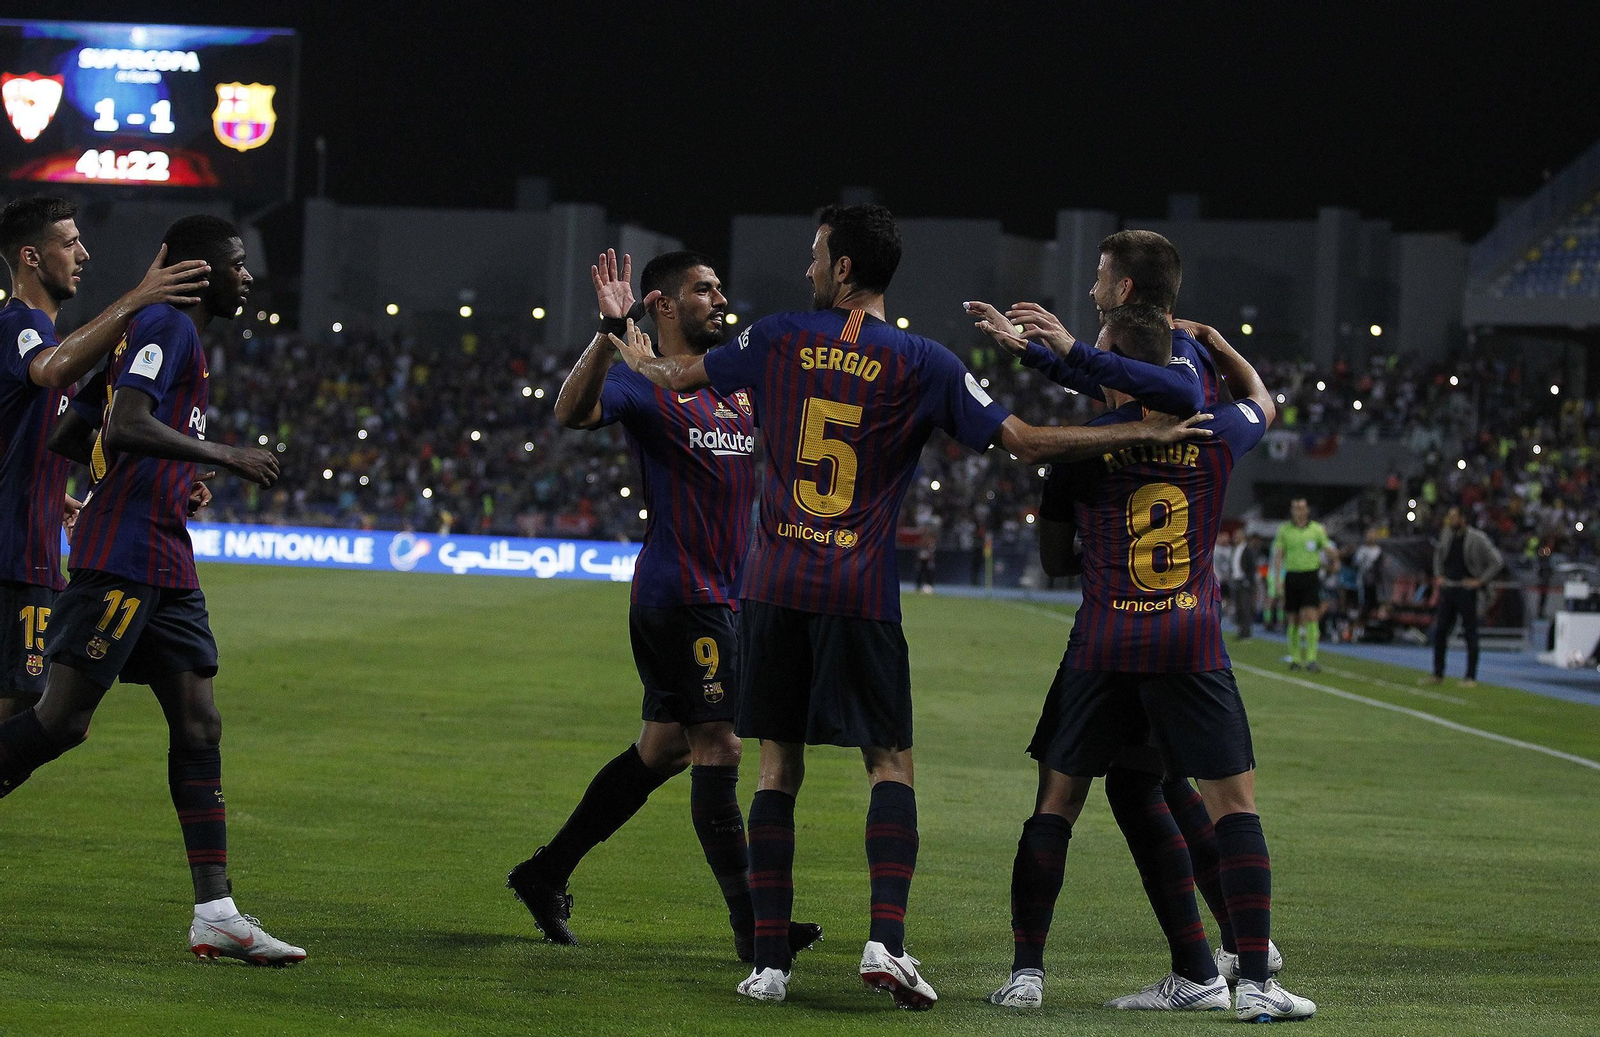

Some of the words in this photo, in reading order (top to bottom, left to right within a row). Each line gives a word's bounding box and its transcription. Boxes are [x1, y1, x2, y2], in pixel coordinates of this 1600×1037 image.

[93, 98, 119, 132] 1
[149, 100, 175, 133] 1
[75, 149, 170, 180] 41:22
[800, 346, 882, 382] SERGIO
[688, 427, 754, 453] Rakute
[793, 397, 863, 518] 5
[225, 530, 375, 564] NATIONALE
[777, 522, 835, 544] unicef
[1126, 483, 1191, 592] 8
[95, 589, 141, 641] 11
[1112, 596, 1174, 612] unicef
[19, 605, 52, 652] 15
[693, 636, 720, 680] 9
